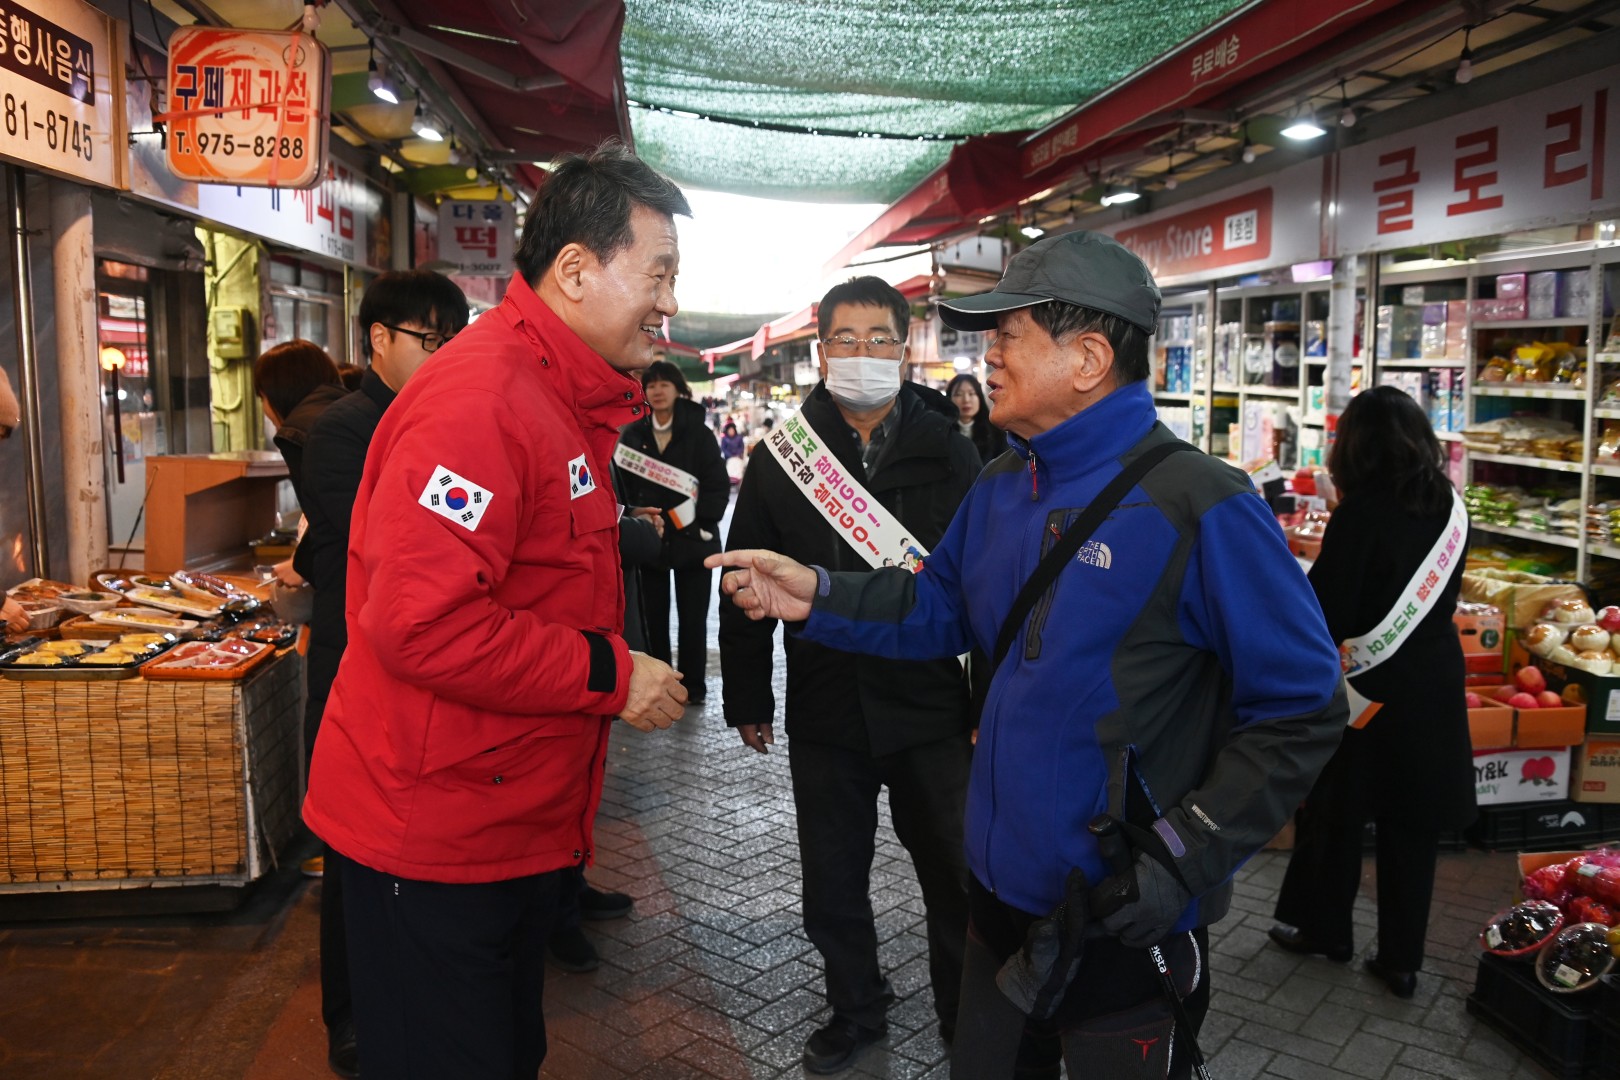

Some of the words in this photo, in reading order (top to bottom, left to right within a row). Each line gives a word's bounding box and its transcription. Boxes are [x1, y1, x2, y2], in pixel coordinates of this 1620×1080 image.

[1191, 35, 1240, 82] 무료배송
[175, 65, 307, 124] 구페제과점
[5, 92, 93, 162] 81-8745
[175, 131, 190, 153] T.
[197, 132, 304, 159] 975-8288
[1373, 88, 1609, 235] 글로리
[455, 226, 497, 258] 떡
[1166, 224, 1213, 263] Store
[770, 429, 815, 485] 전통시장
[813, 482, 880, 556] 살리GO!
[783, 416, 818, 458] 장에서
[814, 455, 881, 528] 장보GO!
[1366, 601, 1418, 656] 보내세요
